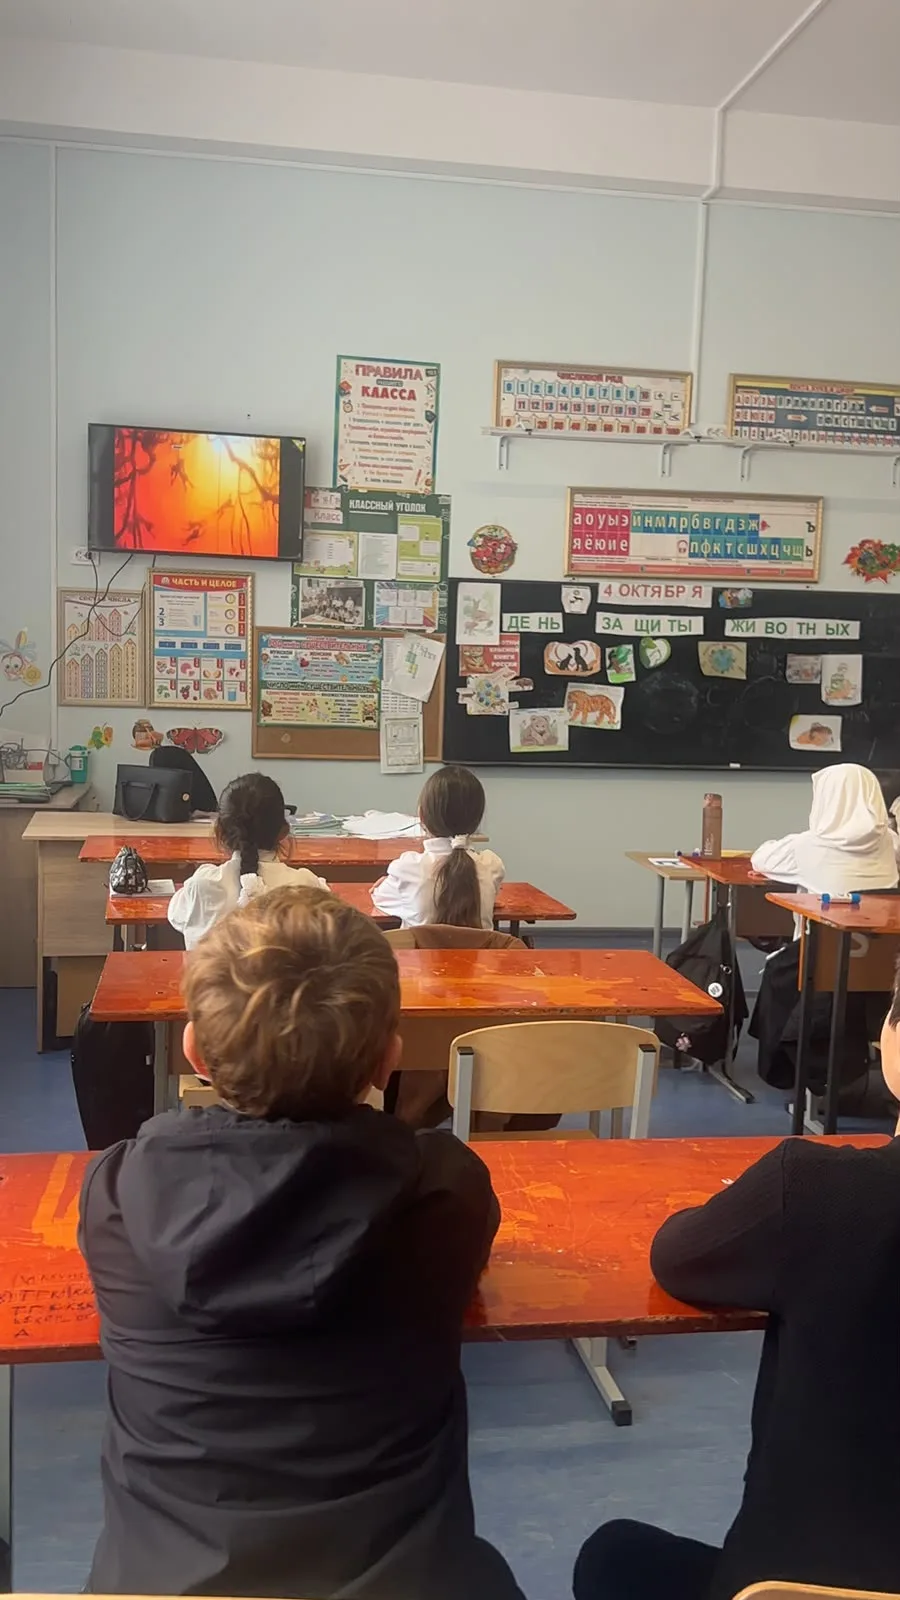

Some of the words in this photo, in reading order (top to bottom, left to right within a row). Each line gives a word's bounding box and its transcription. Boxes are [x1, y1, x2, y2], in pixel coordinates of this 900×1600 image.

[355, 364, 423, 381] ПРАВИЛА
[361, 386, 417, 401] КЛАССА
[349, 499, 393, 511] КЛАССНЫЙ
[396, 502, 426, 512] УГОЛОК
[172, 577, 199, 586] ЧАСТЬ
[209, 579, 237, 588] ЦЕЛОЕ
[604, 584, 612, 597] 4
[159, 607, 165, 616] 2
[159, 618, 165, 626] 3
